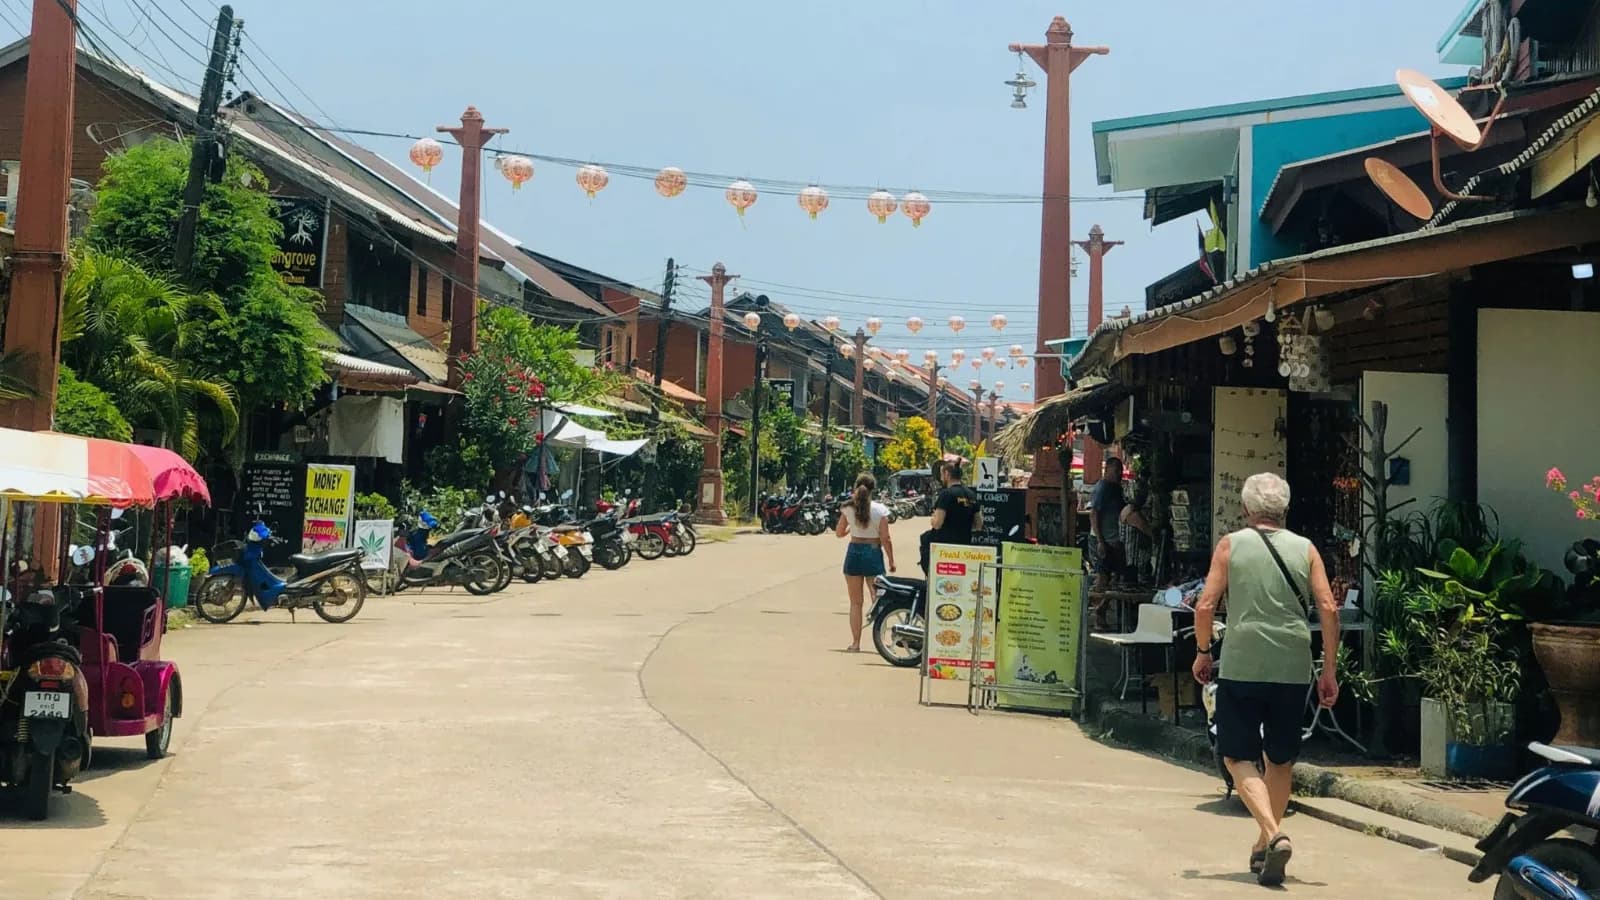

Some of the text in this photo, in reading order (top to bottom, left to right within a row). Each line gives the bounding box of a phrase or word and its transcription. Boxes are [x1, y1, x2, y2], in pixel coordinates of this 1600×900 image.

[271, 252, 316, 269] angrove
[313, 472, 342, 490] MONEY
[304, 496, 345, 516] EXCHANGE
